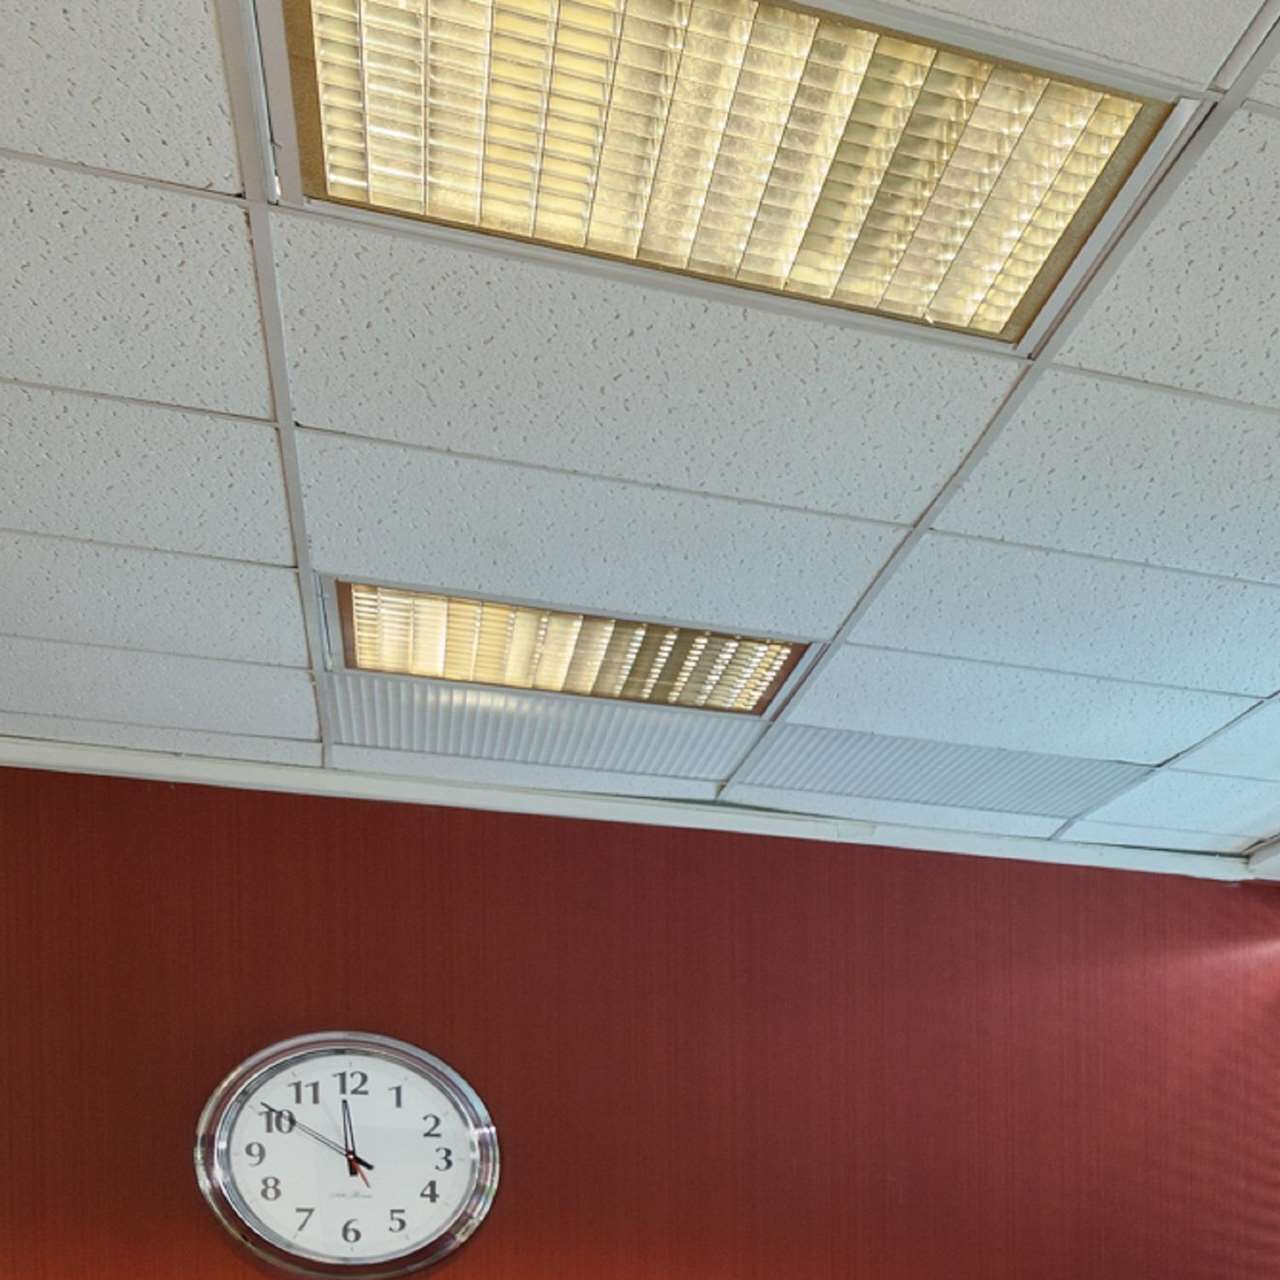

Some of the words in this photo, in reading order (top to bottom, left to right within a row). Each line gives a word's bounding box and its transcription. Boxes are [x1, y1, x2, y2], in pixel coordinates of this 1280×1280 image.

[288, 1081, 320, 1104] 11
[332, 1071, 369, 1095] 12
[388, 1085, 402, 1108] 1
[259, 1109, 295, 1134] 10
[423, 1114, 442, 1137] 2
[245, 1142, 266, 1166] 9
[434, 1147, 453, 1171] 3
[260, 1176, 282, 1200] 8
[420, 1180, 439, 1203] 4
[295, 1208, 315, 1231] 7
[341, 1219, 361, 1243] 6
[389, 1209, 406, 1233] 5
